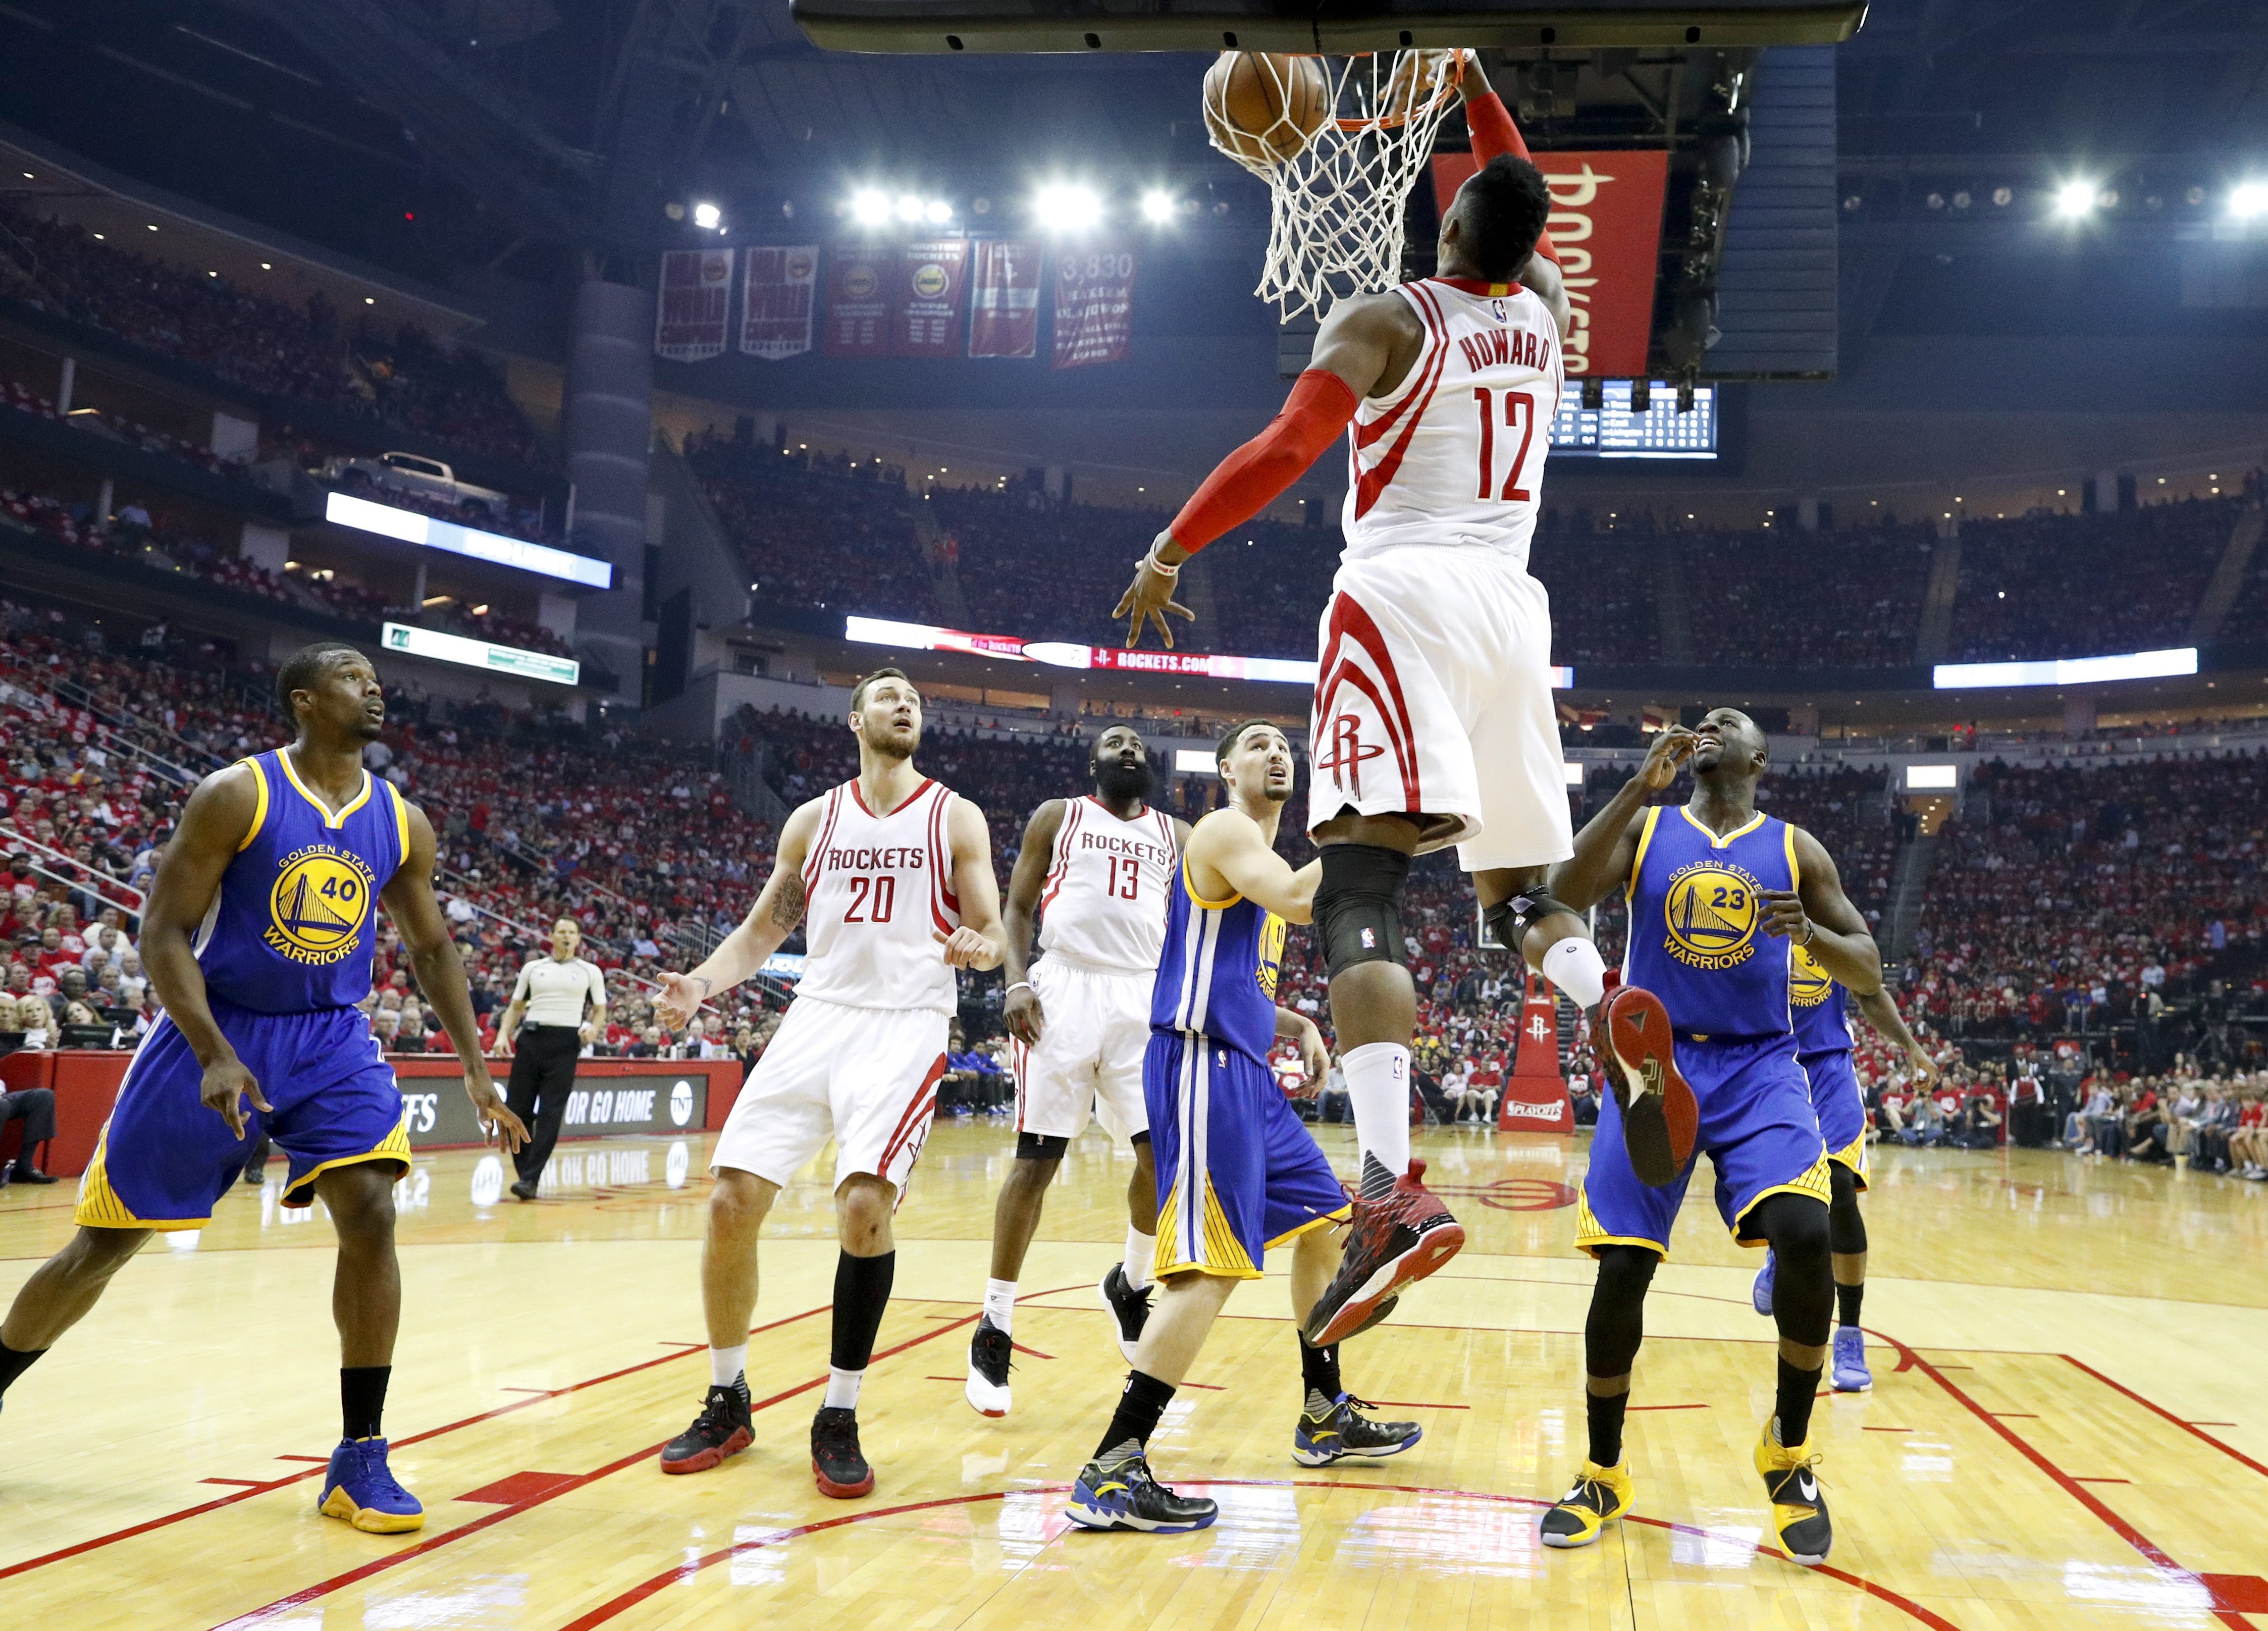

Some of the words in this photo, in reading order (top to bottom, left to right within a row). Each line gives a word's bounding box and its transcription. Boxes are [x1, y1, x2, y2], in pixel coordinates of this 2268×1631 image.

[1458, 329, 1550, 373] HOWARD
[1472, 386, 1536, 503] 12
[1117, 652, 1212, 673] ROCKETS.COM
[278, 844, 337, 868] GOLDEN
[341, 850, 376, 884] STATE
[828, 846, 924, 871] ROCKETS
[1081, 831, 1167, 866] ROCKETS
[320, 876, 356, 902] 40
[1107, 855, 1139, 901] 13
[1668, 860, 1724, 882] GOLDEN
[1728, 864, 1764, 891] STATE
[843, 875, 896, 924] 20
[1711, 886, 1745, 910] 23
[263, 924, 360, 966] WARRIORS
[1663, 934, 1755, 970] WARRIORS
[1806, 954, 1820, 966] 3
[564, 1090, 590, 1125] OR
[590, 1090, 614, 1124] GO
[613, 1089, 657, 1123] HOME
[1514, 1103, 1563, 1117] PLAYOFFS
